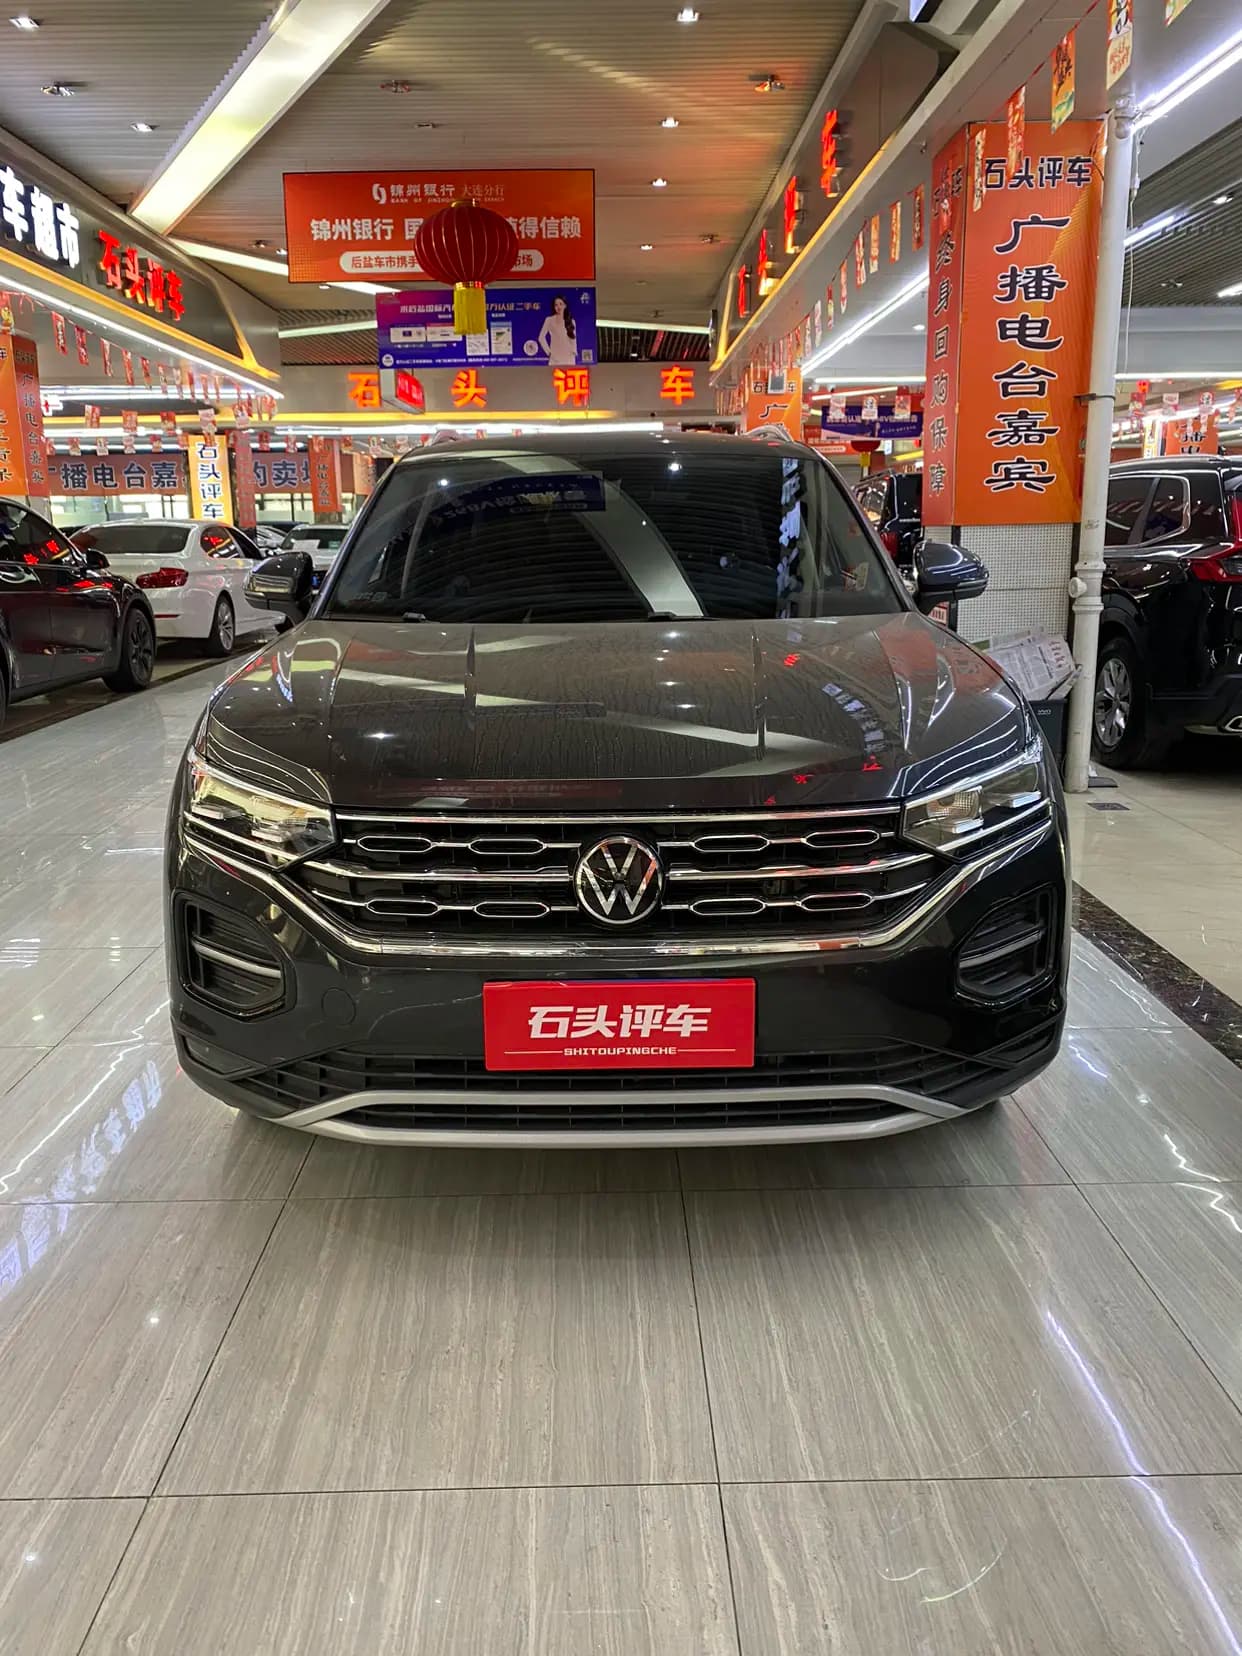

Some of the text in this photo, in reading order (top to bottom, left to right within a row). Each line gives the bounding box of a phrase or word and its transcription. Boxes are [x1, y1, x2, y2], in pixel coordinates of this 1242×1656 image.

[984, 156, 1092, 188] 石头评车
[310, 218, 394, 240] 锦州银行
[984, 213, 1072, 492] 广播电台嘉宾
[48, 462, 187, 490] 播电台嘉
[197, 443, 225, 519] 石头评车
[529, 1003, 711, 1039] 石头评车
[564, 1046, 677, 1056] SHITOUPINGCHE
